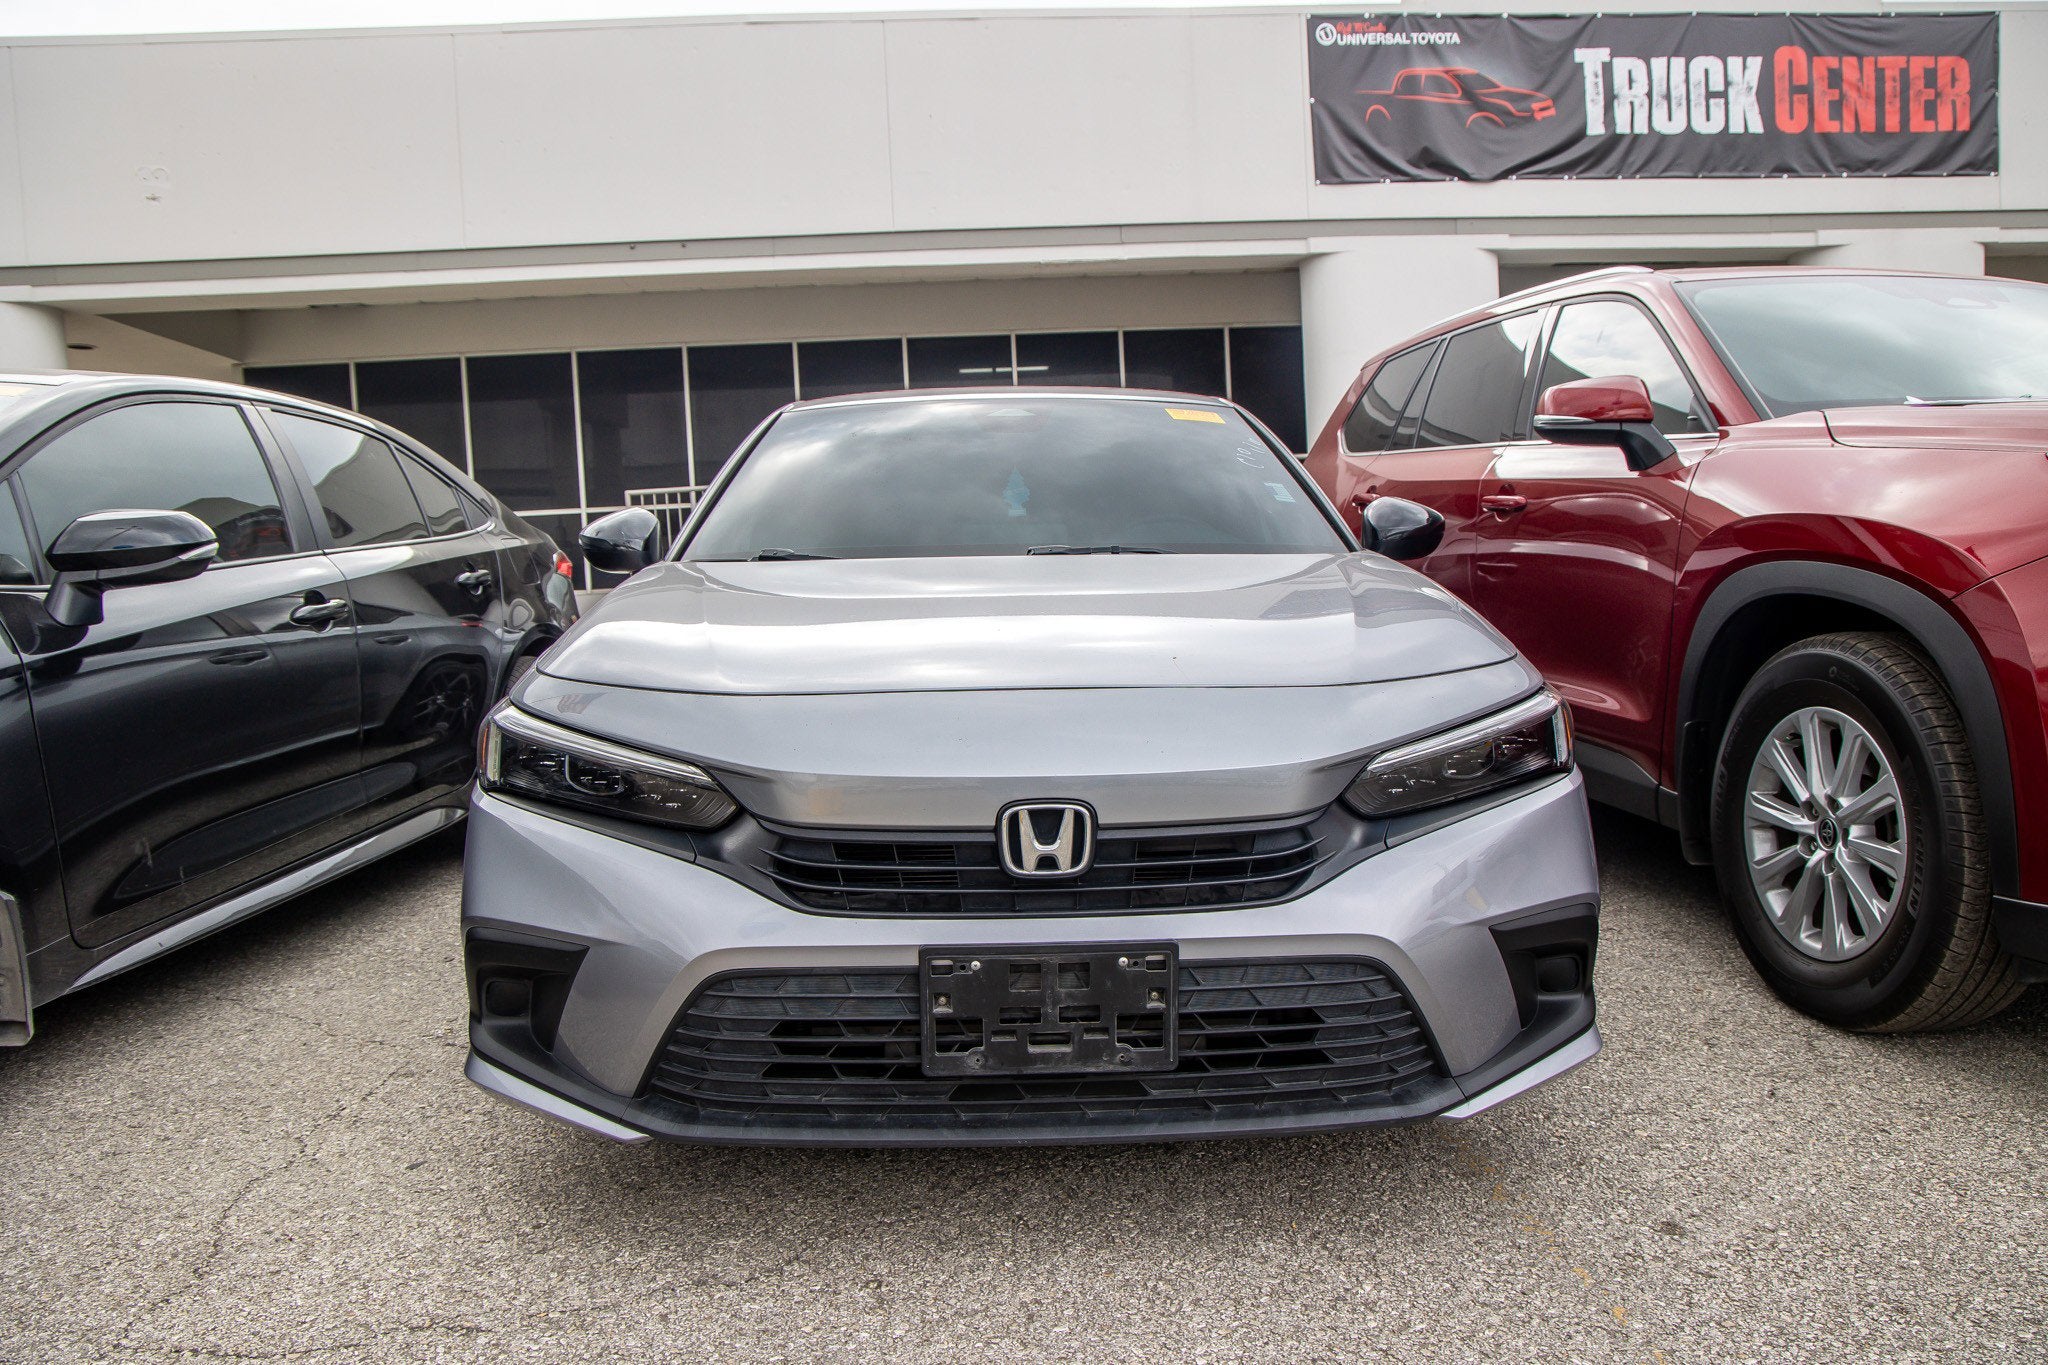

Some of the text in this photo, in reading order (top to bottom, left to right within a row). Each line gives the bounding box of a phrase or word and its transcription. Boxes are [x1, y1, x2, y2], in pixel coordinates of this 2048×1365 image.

[1336, 32, 1461, 46] UNIVERSAL TOYOTA
[1573, 45, 1971, 136] TRUCK CENTER
